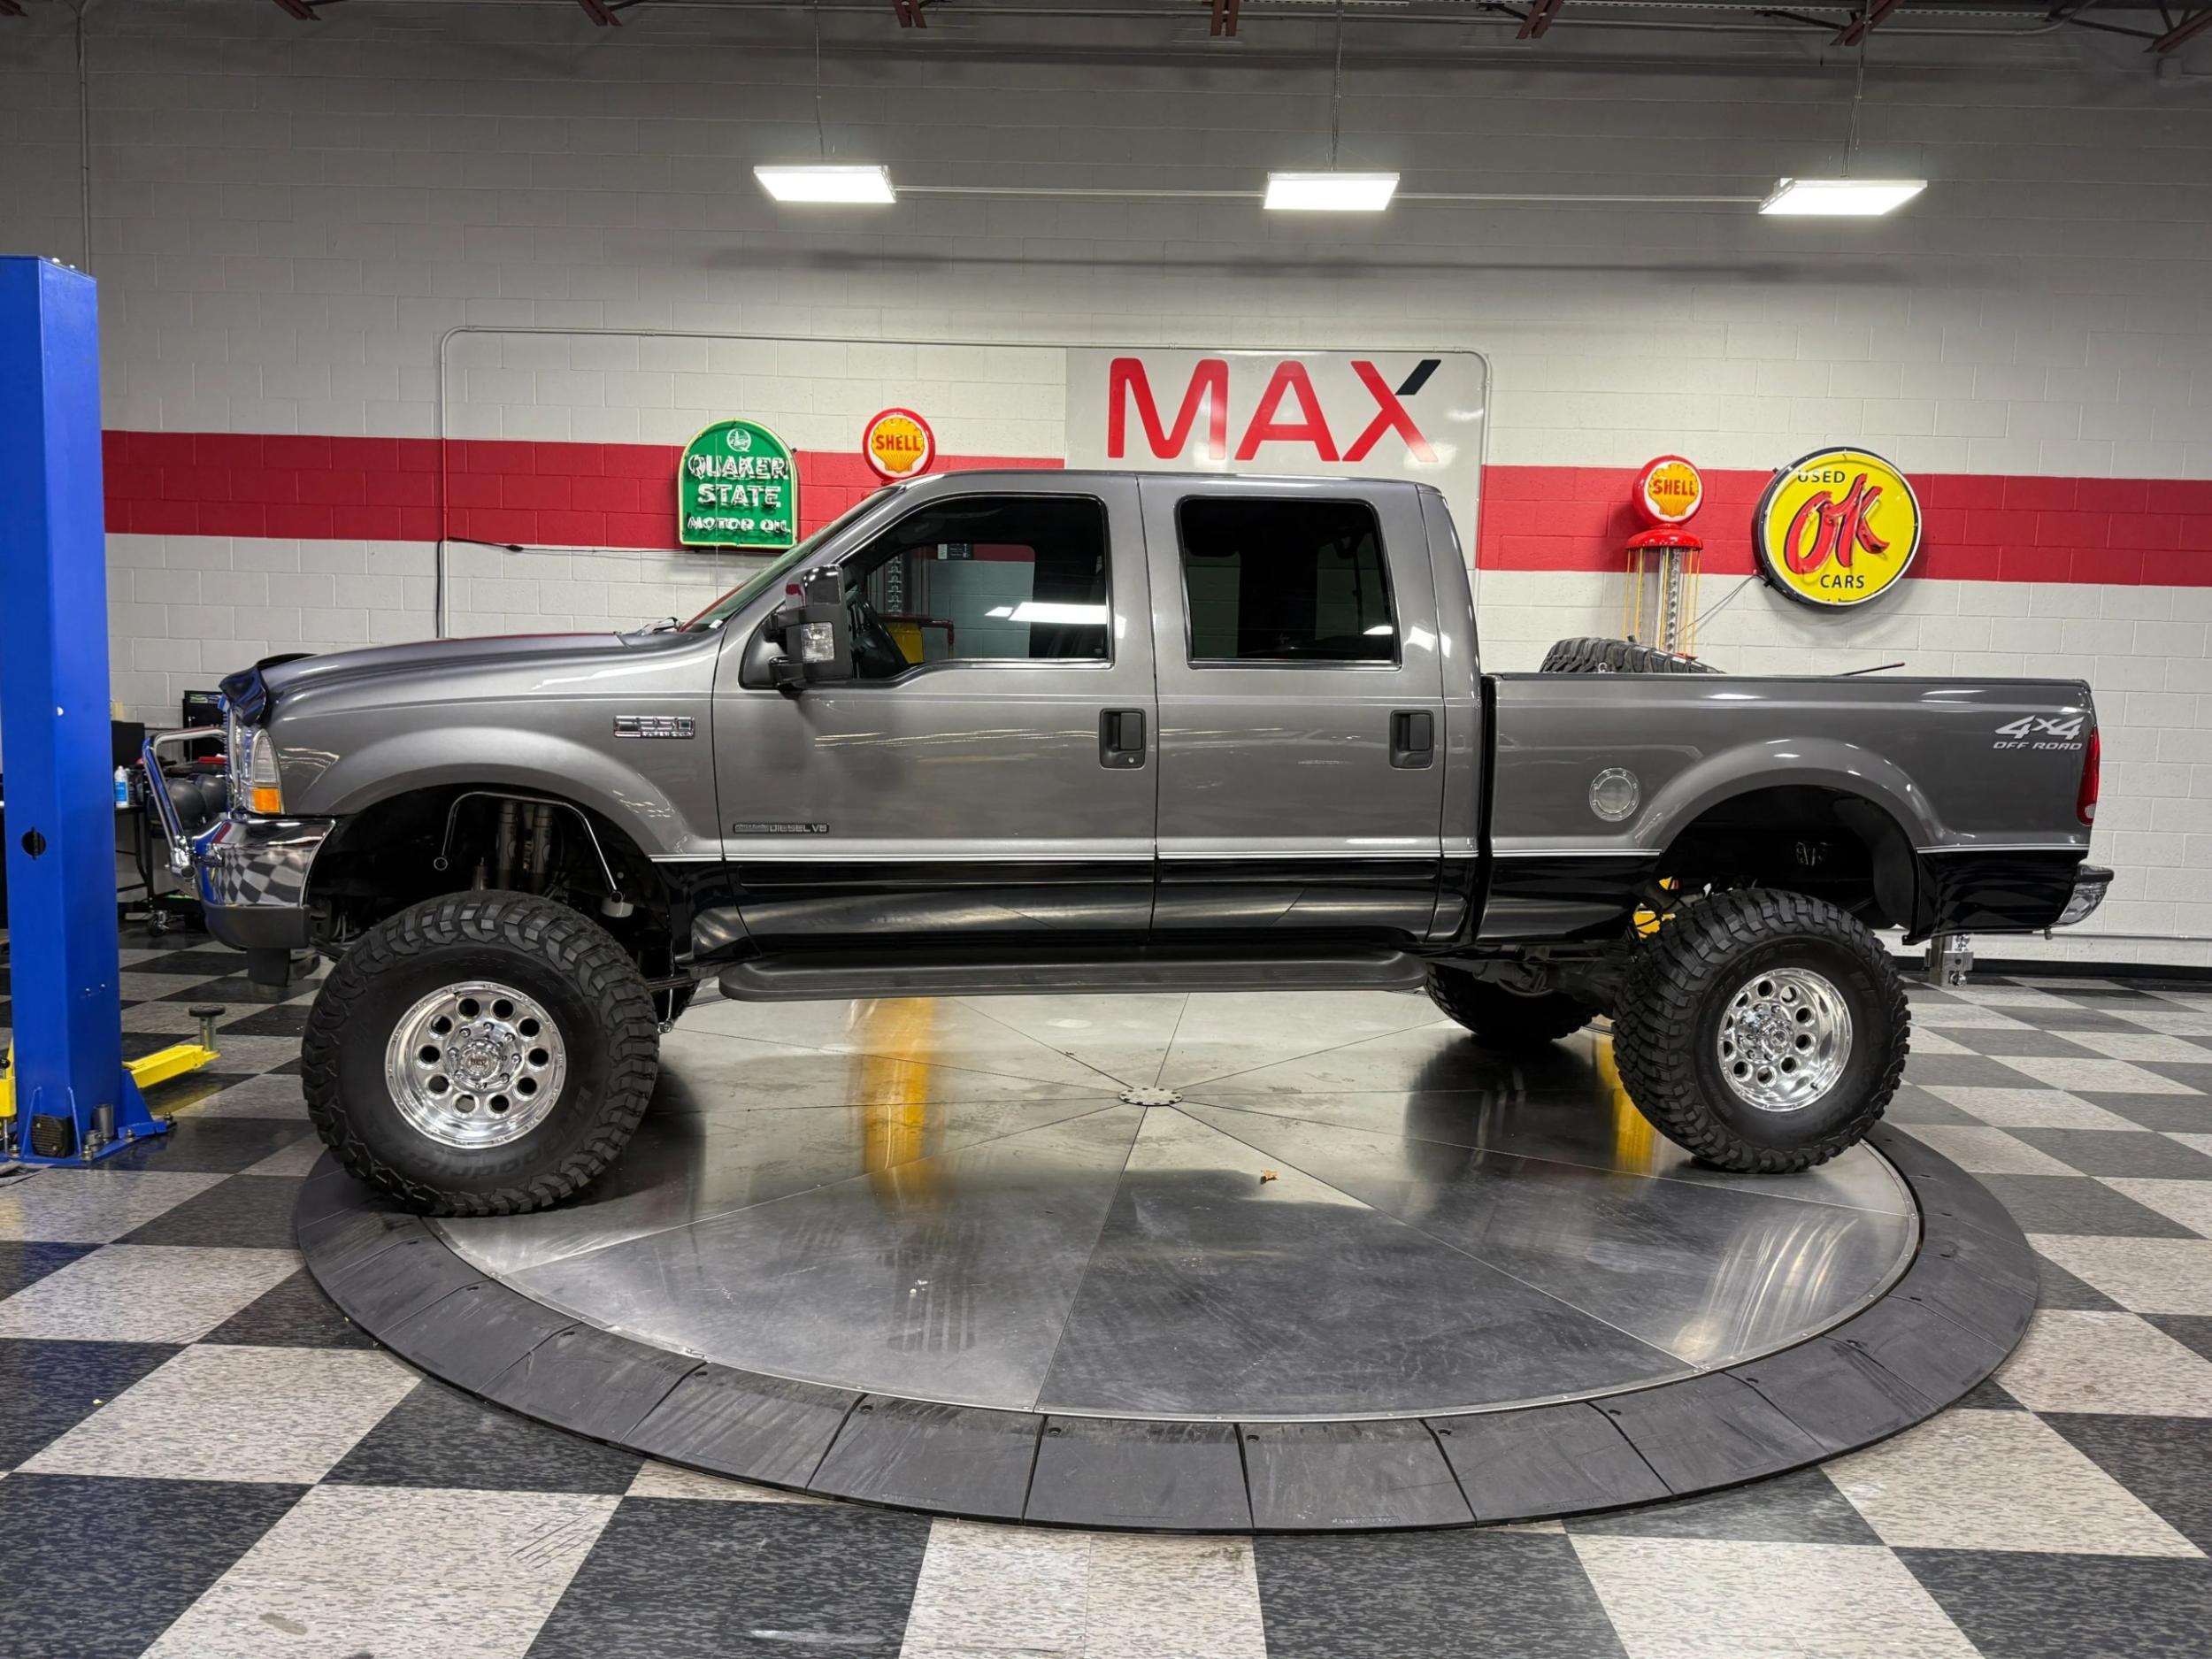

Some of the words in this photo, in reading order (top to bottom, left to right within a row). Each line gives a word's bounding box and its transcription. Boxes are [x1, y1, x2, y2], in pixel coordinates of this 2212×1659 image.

[1108, 357, 1441, 462] MAX
[875, 434, 921, 452] SHELL
[688, 454, 789, 480] QUAKER
[1797, 470, 1845, 484] USED
[697, 484, 781, 508] STATE
[1652, 479, 1695, 496] SHELL
[687, 516, 755, 532] MOTOR
[760, 518, 790, 533] OIL
[1820, 574, 1865, 588] CARS
[770, 824, 811, 833] DIESEL
